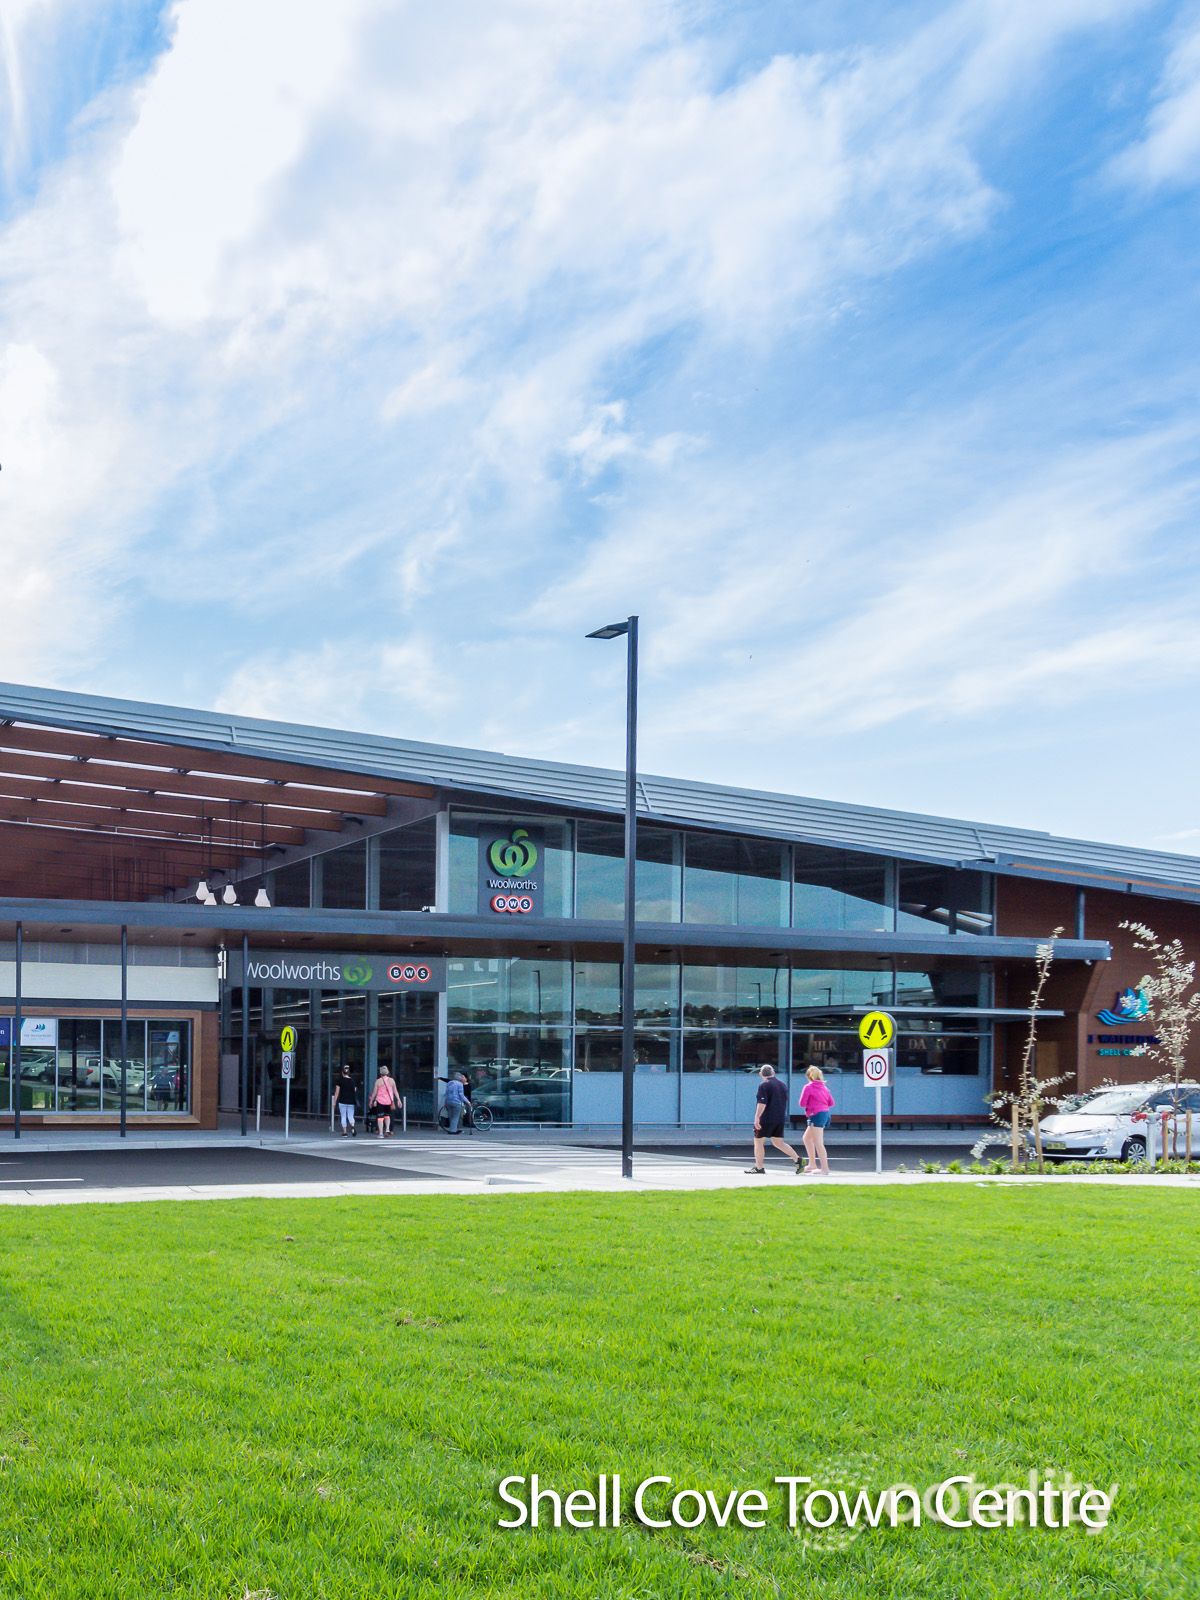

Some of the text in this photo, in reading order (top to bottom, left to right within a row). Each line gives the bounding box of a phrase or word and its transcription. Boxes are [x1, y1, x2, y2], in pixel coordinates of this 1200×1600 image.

[489, 879, 538, 890] Woolworths
[391, 966, 428, 978] BWS
[871, 1061, 882, 1074] 10
